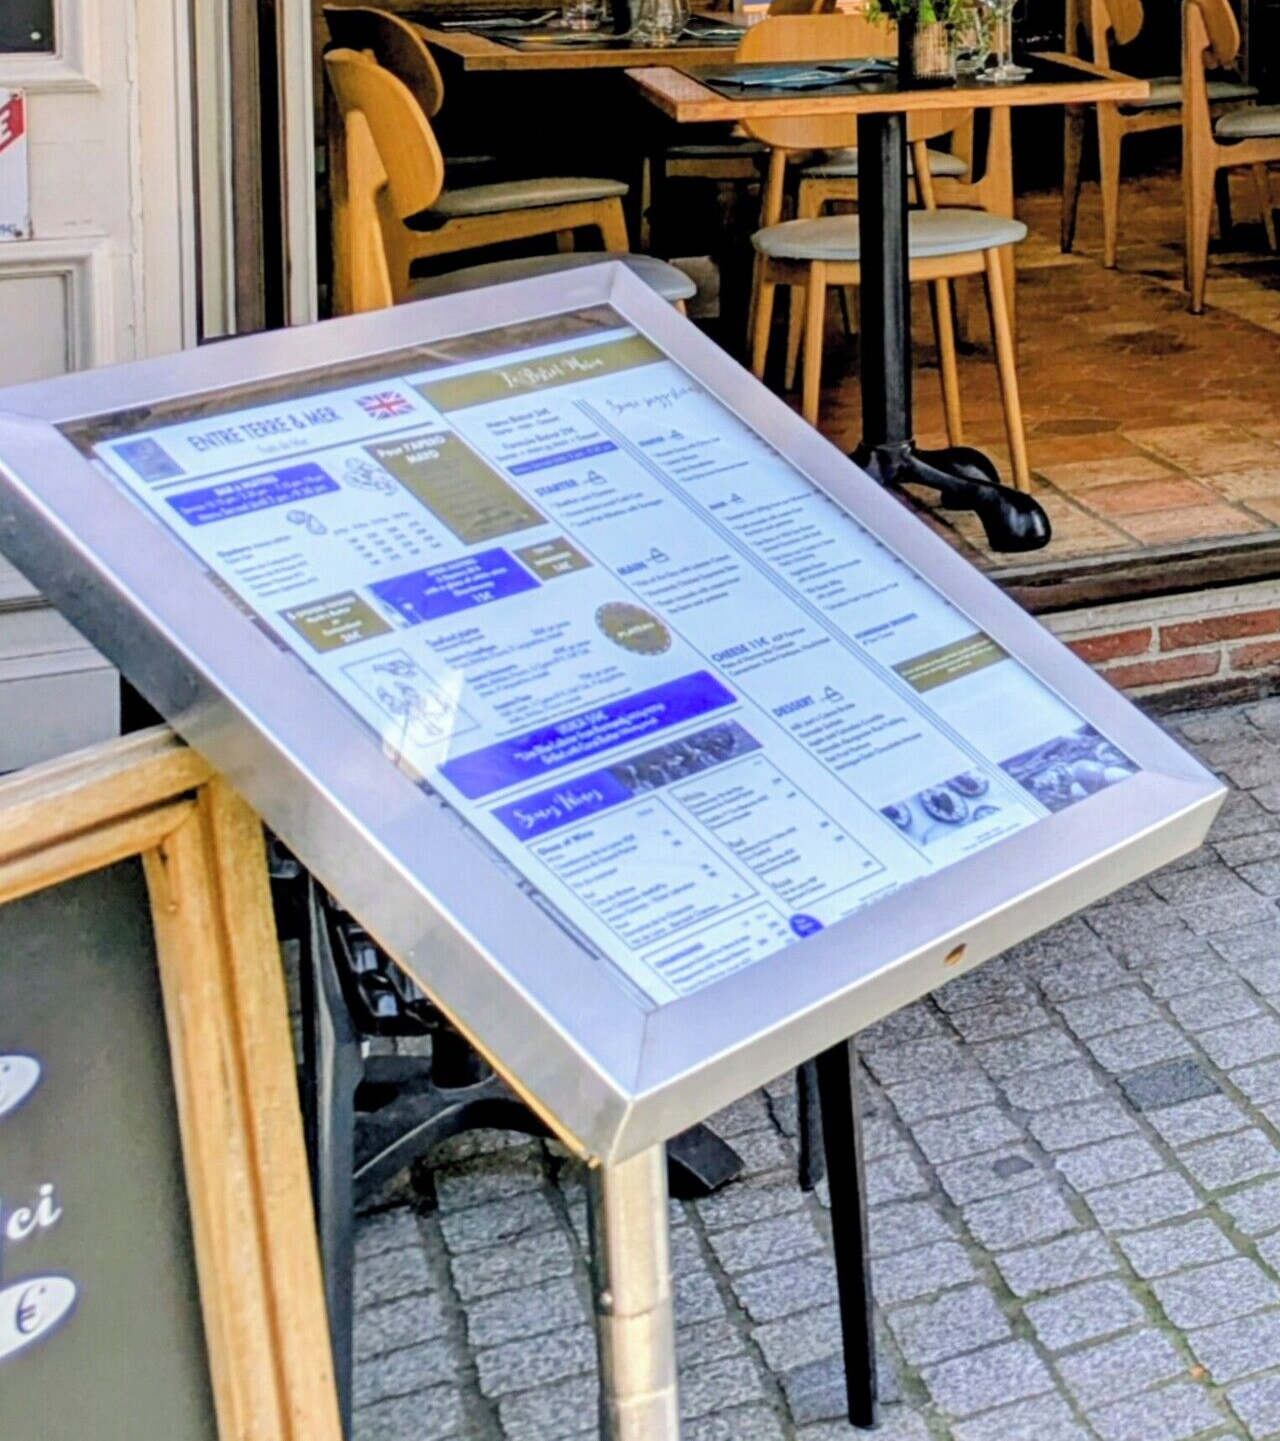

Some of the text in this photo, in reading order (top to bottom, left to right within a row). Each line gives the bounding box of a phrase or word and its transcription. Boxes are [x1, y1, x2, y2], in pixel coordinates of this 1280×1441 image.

[184, 405, 344, 452] ENTRE TERRE & MER
[532, 478, 580, 496] STARTER
[614, 560, 649, 575] MAIN
[708, 643, 751, 663] CHEESE
[769, 695, 817, 717] DESSERT
